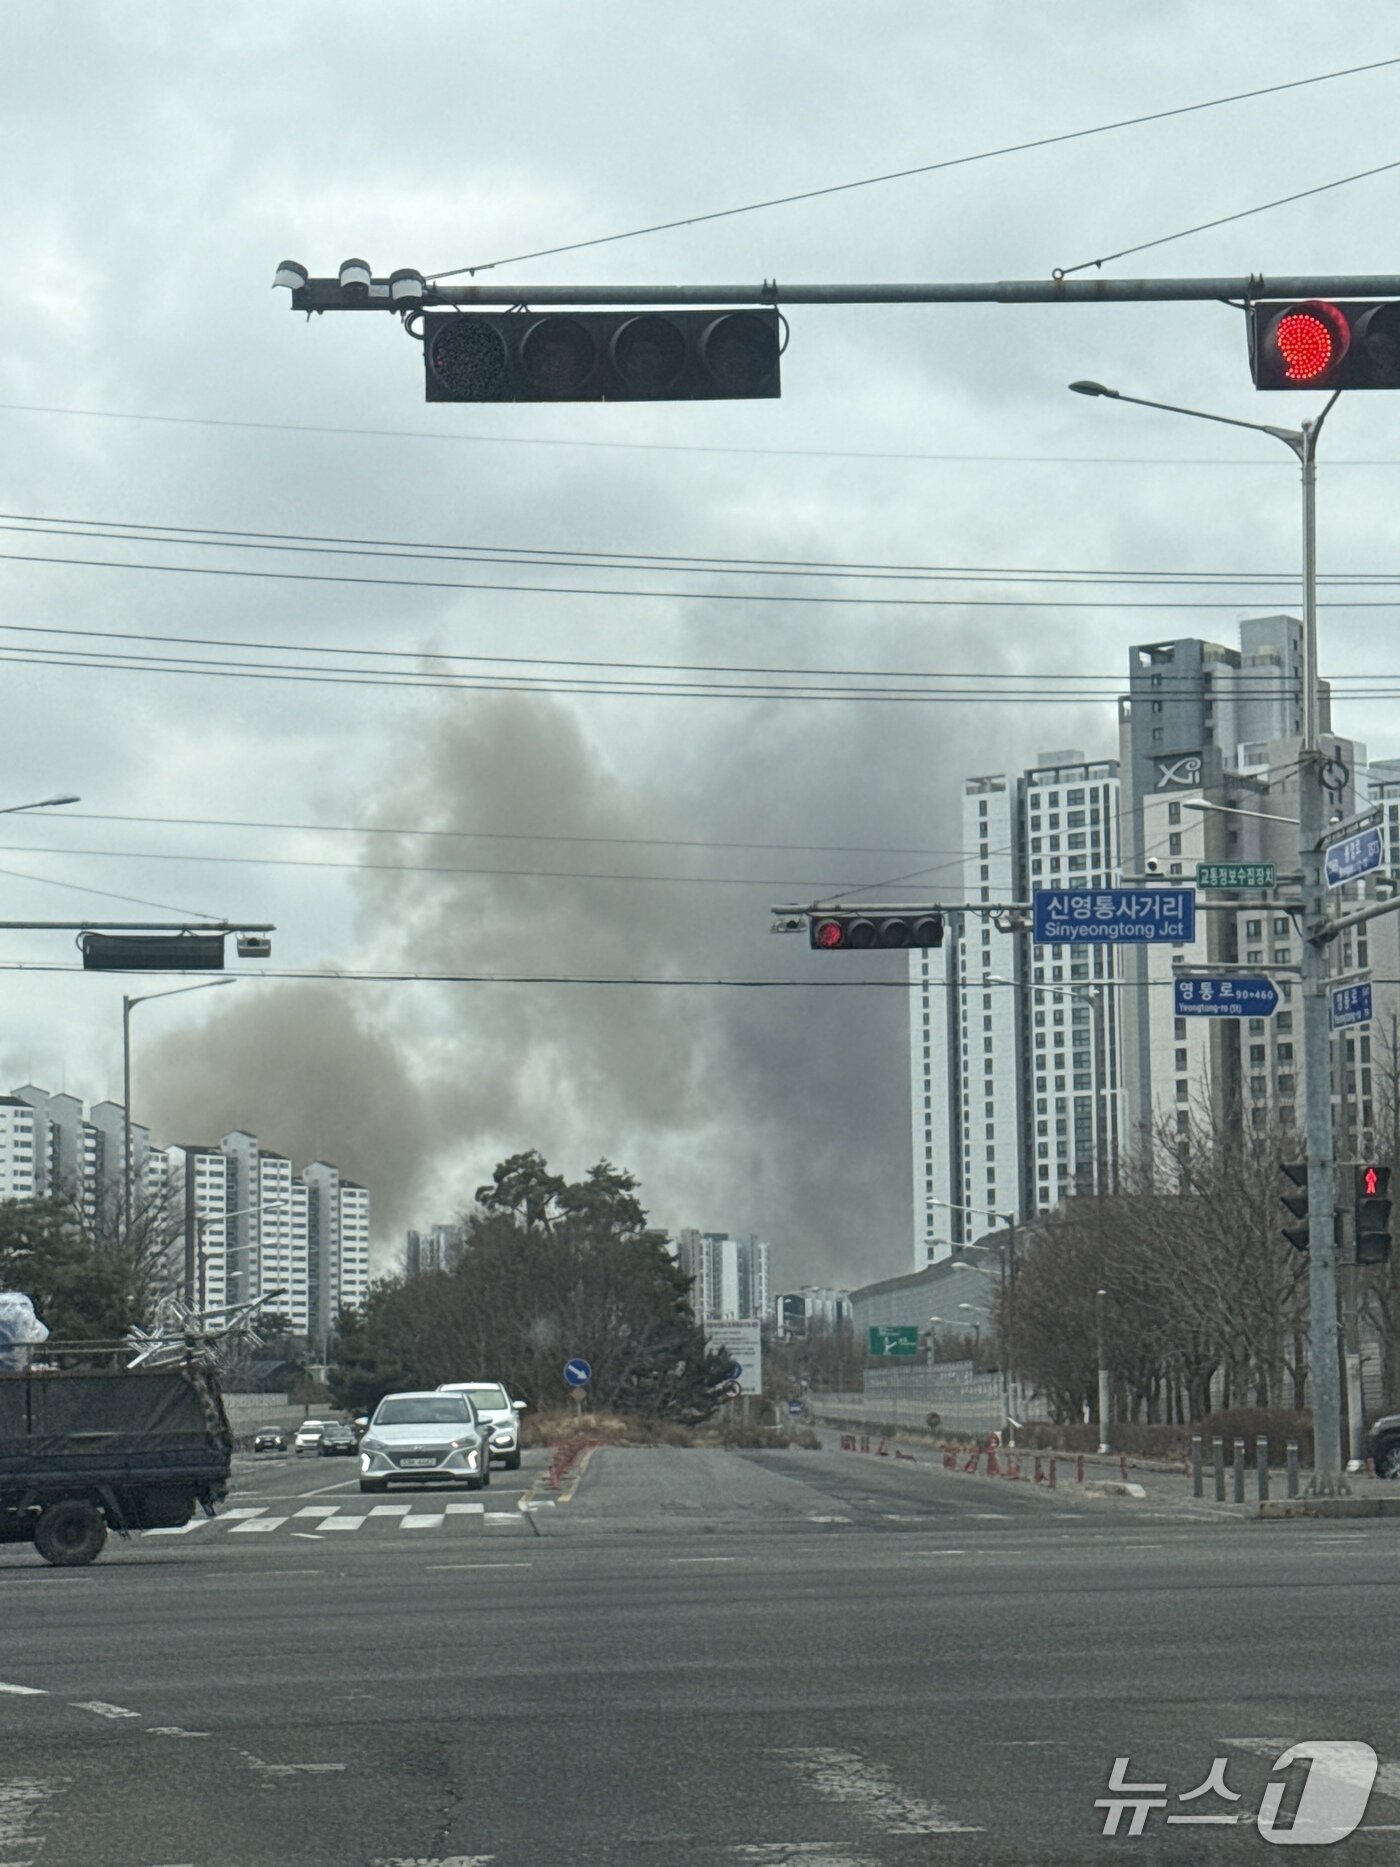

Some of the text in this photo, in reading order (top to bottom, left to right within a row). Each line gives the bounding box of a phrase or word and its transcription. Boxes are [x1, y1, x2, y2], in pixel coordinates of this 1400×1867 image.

[1200, 867, 1274, 887] 교통정보수집장치
[1046, 894, 1184, 920] 신영통사거리
[1045, 921, 1183, 939] Sinyeongtong Jct
[1179, 981, 1234, 1001] 영통로
